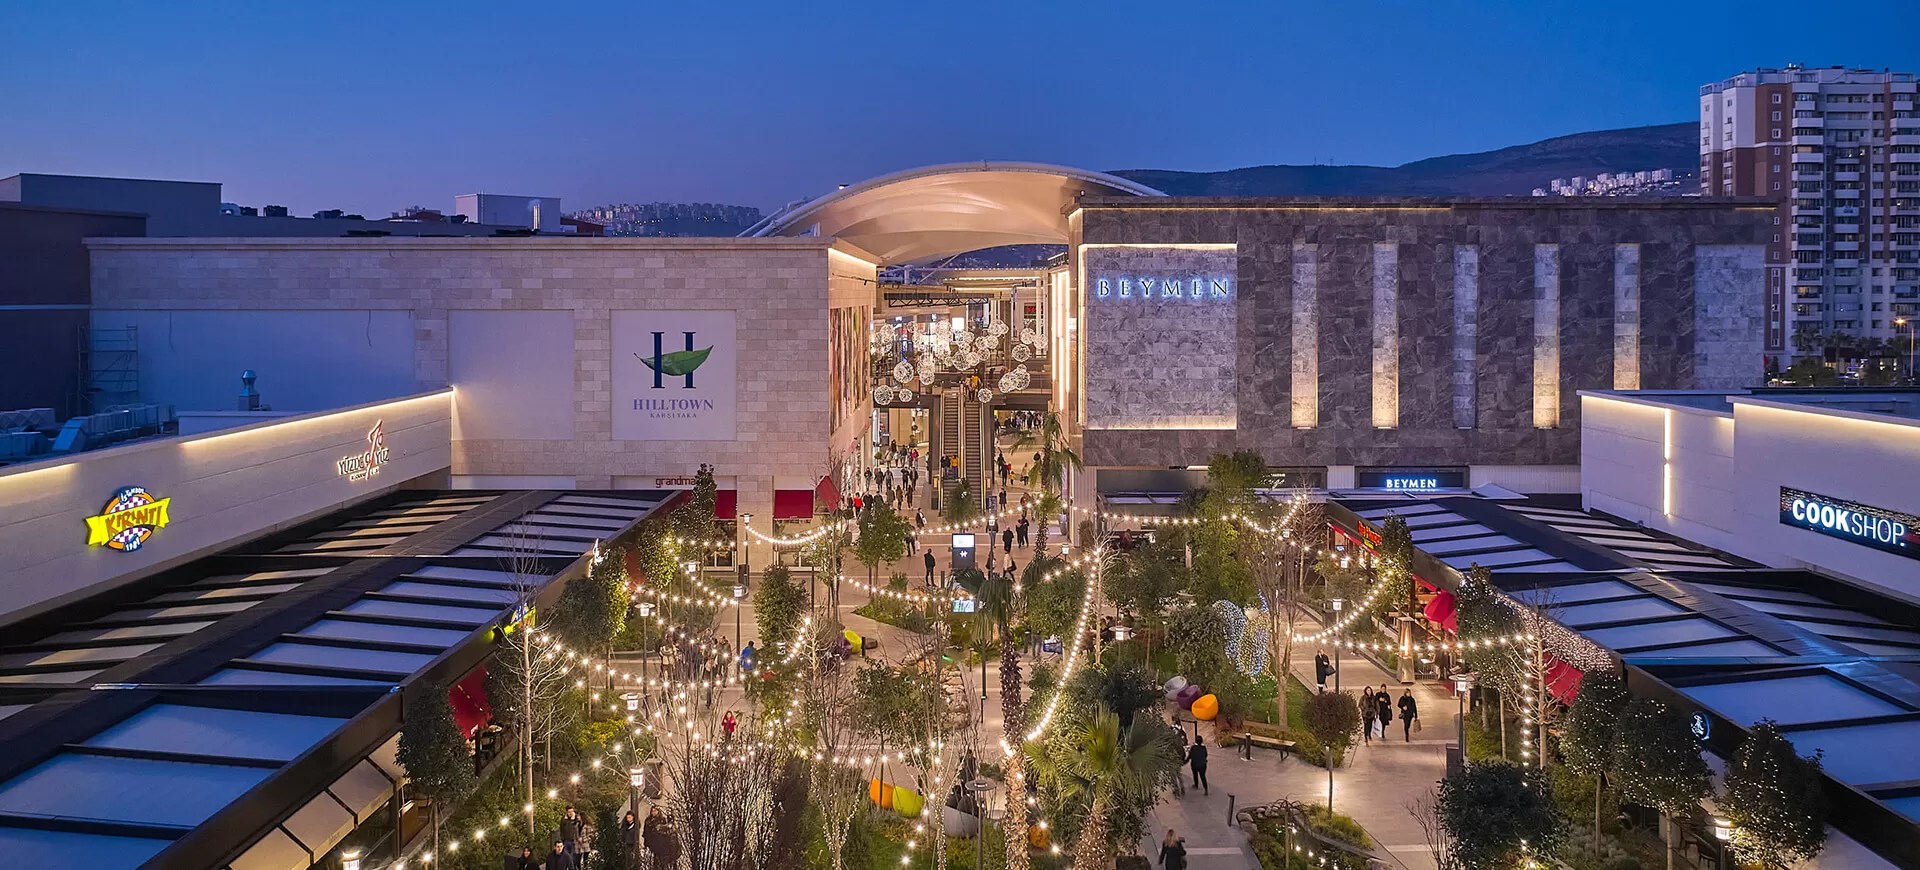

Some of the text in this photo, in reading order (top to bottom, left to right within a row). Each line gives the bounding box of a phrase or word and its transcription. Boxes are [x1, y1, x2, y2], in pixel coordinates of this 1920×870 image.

[1098, 279, 1229, 297] BEYMEN
[633, 399, 714, 411] HILLTOWN
[655, 475, 696, 488] grandma
[1386, 479, 1436, 488] BEYMEN
